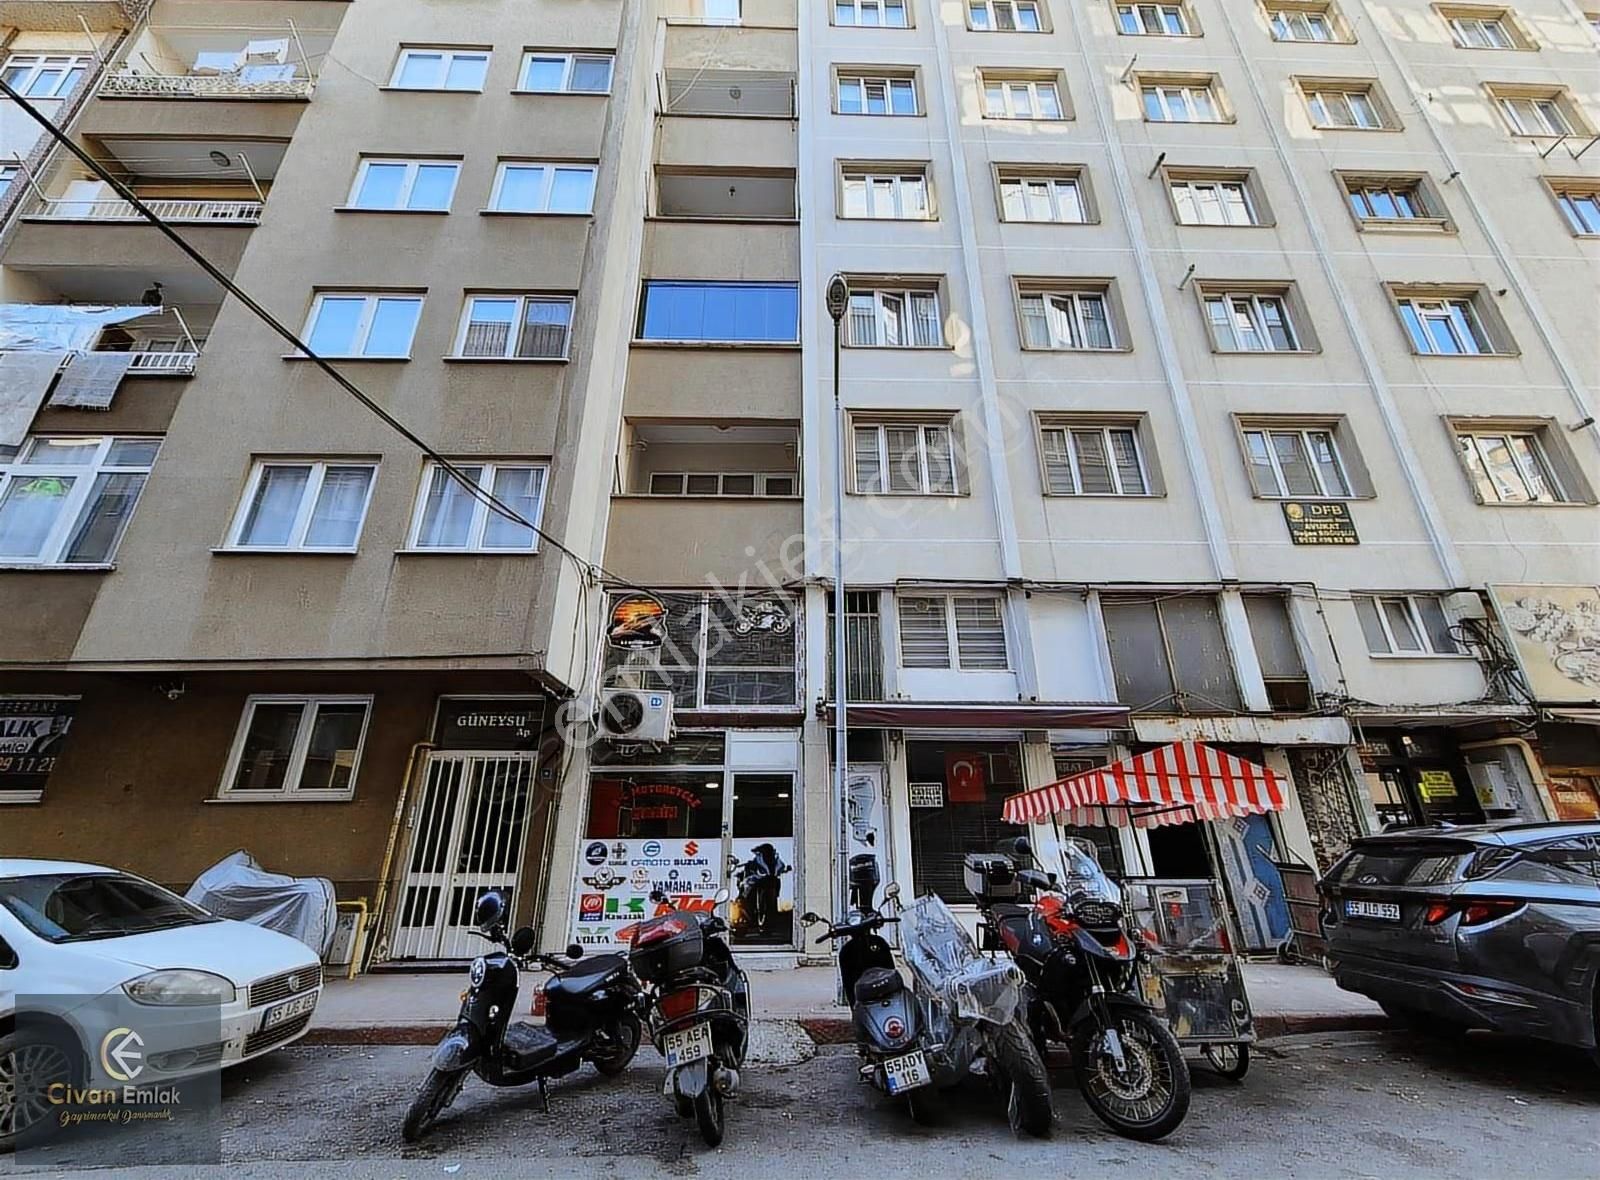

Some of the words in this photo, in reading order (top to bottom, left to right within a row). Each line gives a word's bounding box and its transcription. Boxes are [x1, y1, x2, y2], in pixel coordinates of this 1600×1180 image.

[1311, 505, 1342, 515] DFB
[457, 712, 526, 727] GÜNEYSU
[674, 858, 709, 866] SUZUKI
[652, 880, 693, 894] YAMAHA
[575, 935, 610, 945] VOLTA
